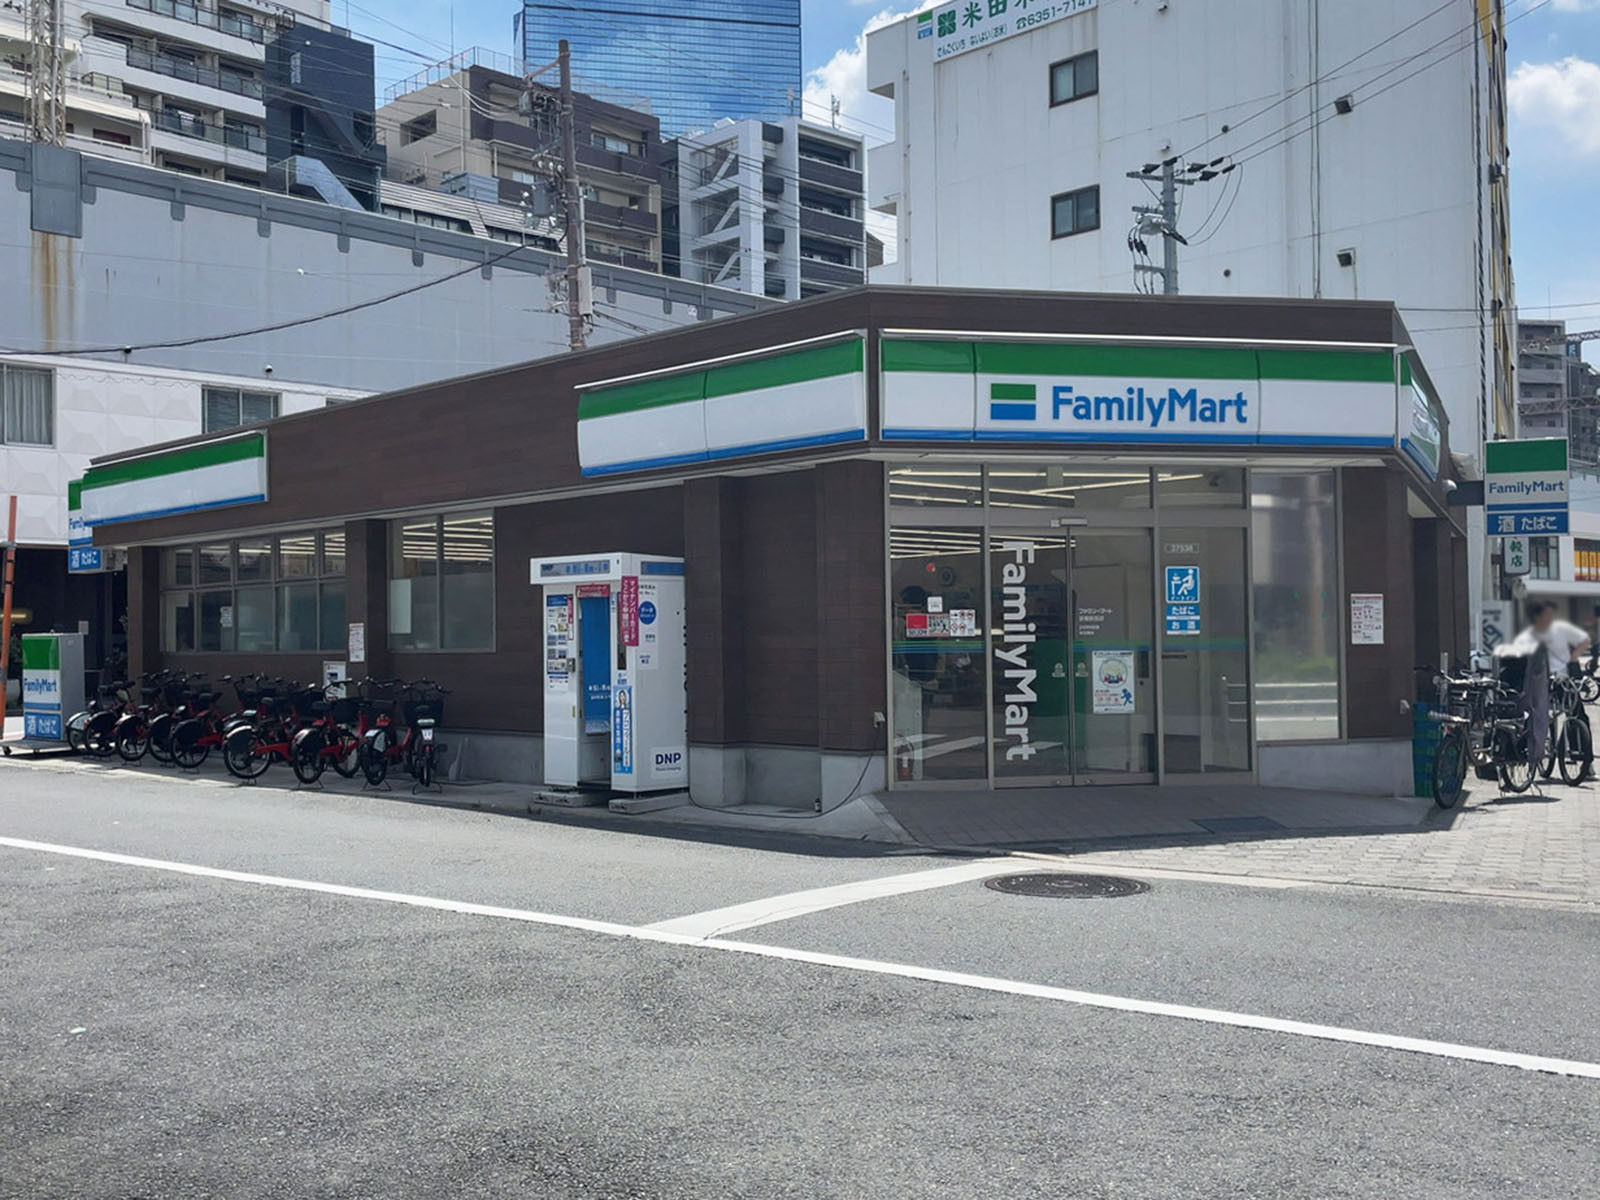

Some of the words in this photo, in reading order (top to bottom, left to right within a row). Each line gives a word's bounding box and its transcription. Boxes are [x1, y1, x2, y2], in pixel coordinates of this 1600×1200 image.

[1052, 385, 1248, 428] FamilyMart
[1489, 480, 1565, 496] FamilyMart
[1498, 515, 1515, 533] 酒
[1521, 515, 1557, 531] たばこ
[1508, 537, 1524, 568] 穀店
[1171, 606, 1195, 616] たばこ
[995, 541, 1038, 761] FamilyMart
[24, 678, 57, 694] FamilyMart
[655, 752, 682, 765] DNP
